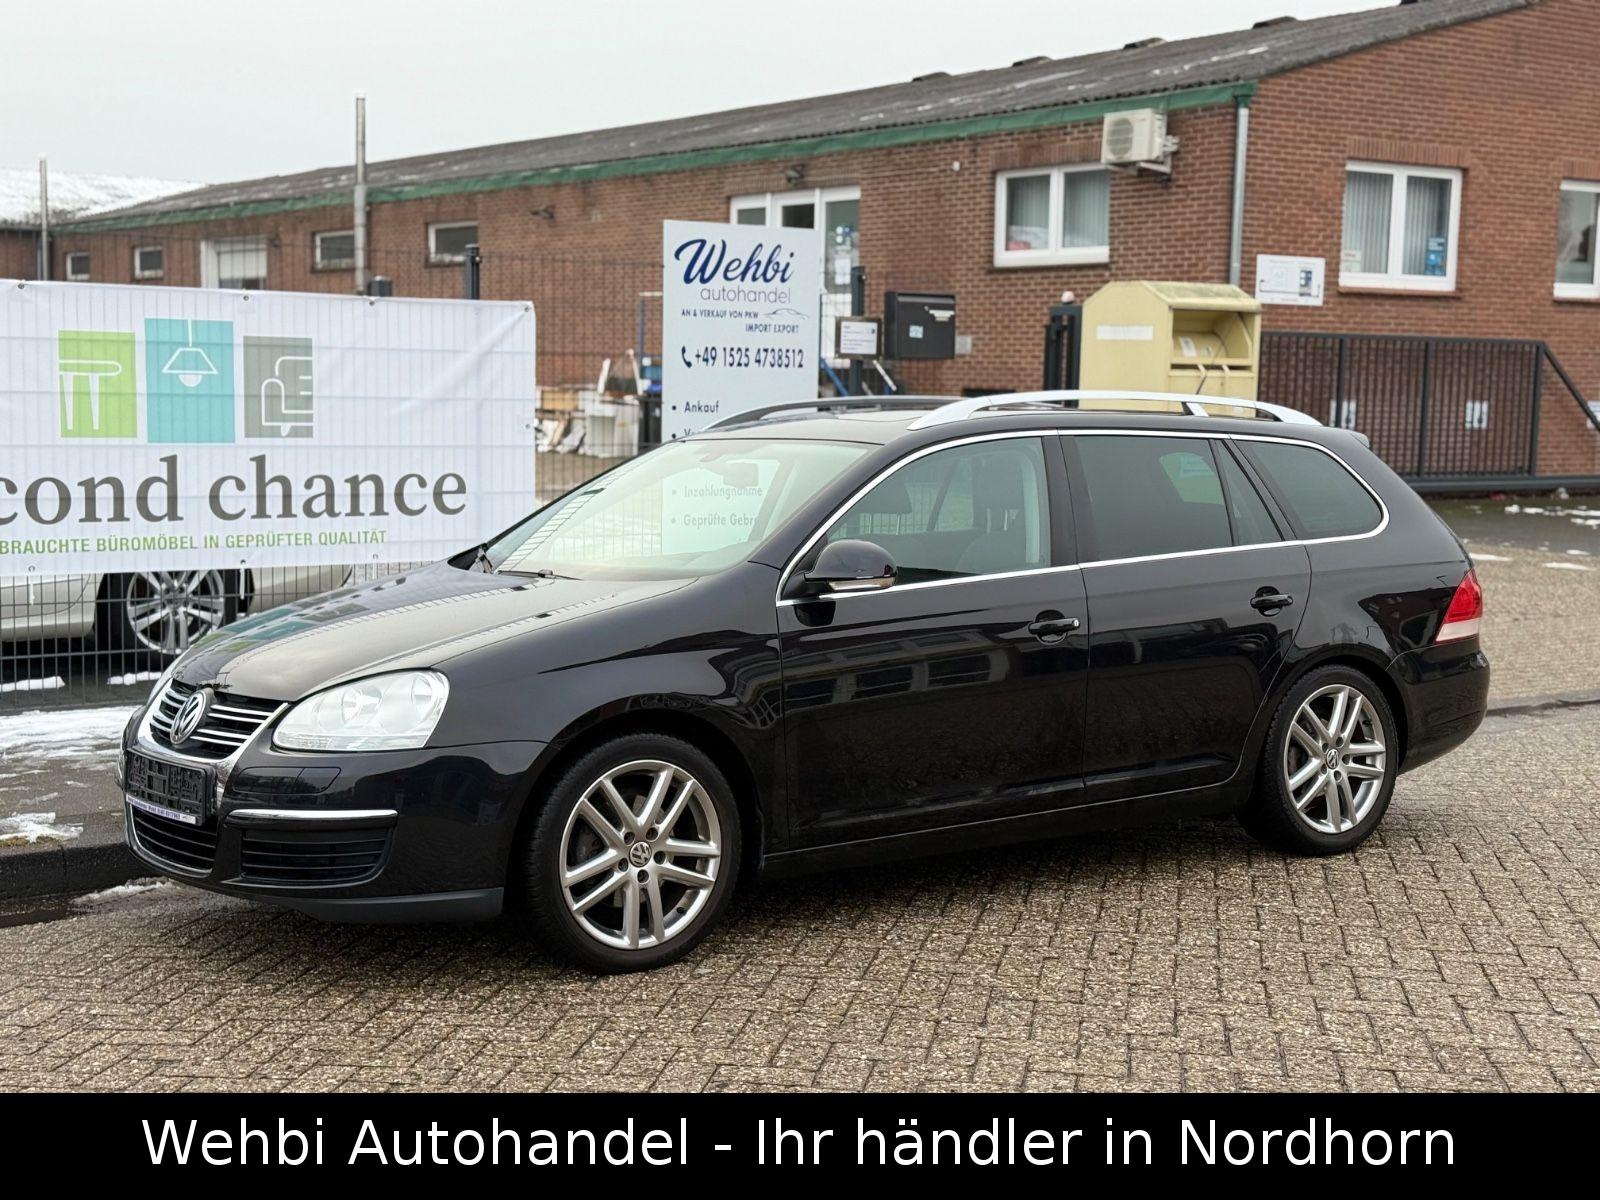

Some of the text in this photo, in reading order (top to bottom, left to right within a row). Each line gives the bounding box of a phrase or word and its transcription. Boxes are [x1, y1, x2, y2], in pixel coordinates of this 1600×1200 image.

[674, 239, 795, 285] Wehbi
[700, 286, 791, 304] autohandel
[681, 308, 691, 318] AN
[700, 309, 728, 319] VERKAUF
[729, 310, 744, 319] VON
[744, 311, 759, 320] PKW
[745, 323, 799, 334] IMPORT EXPORT
[694, 346, 804, 368] +49 1525 4738512
[684, 400, 720, 414] Ankauf
[208, 454, 468, 522] chance
[683, 513, 727, 530] Geprüfte
[0, 527, 388, 556] BRAUCHTE BÜROMÖBEL IN GEPRÜFTER QUALITÄT
